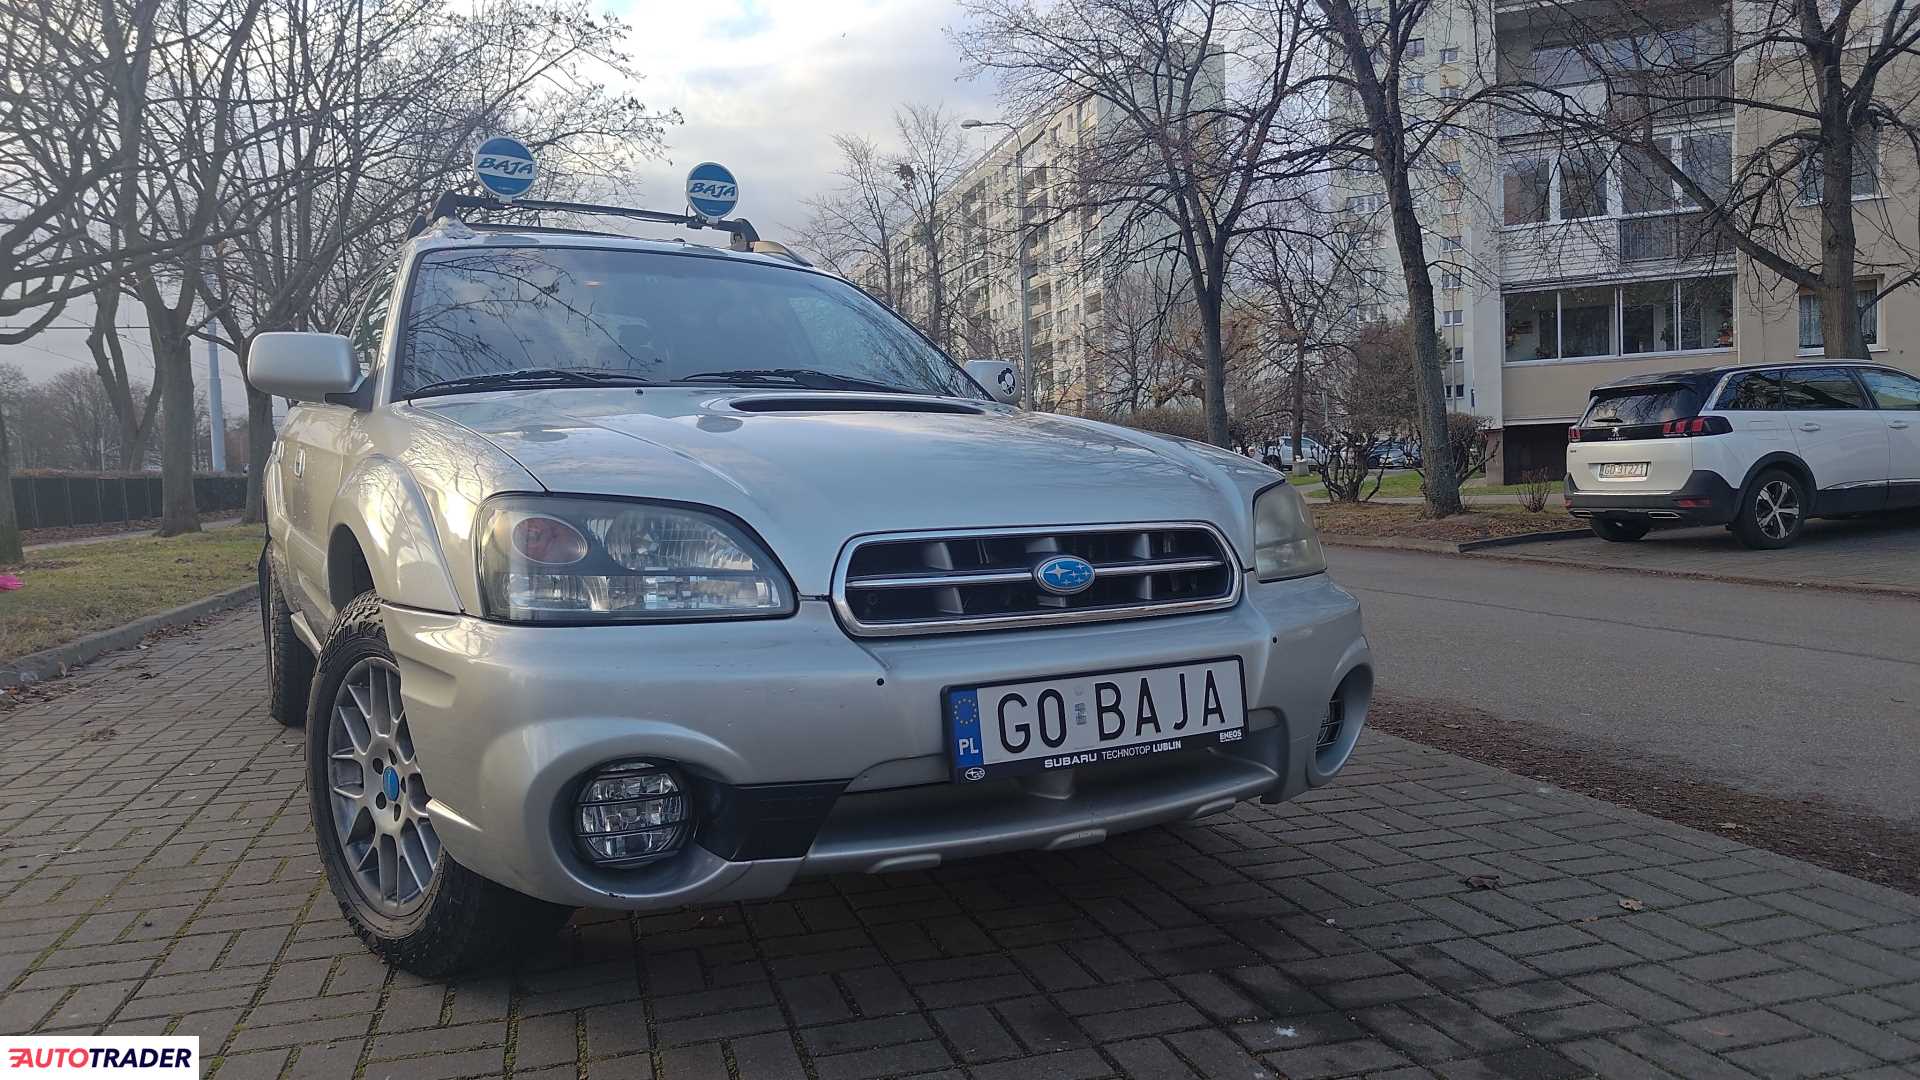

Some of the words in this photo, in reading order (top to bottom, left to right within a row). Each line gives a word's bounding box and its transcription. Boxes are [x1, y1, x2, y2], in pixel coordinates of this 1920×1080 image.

[478, 157, 534, 175] BAJA
[689, 182, 736, 199] BAJA
[1094, 669, 1226, 741] BAJA
[1219, 729, 1242, 741] ENEOS
[958, 737, 979, 756] PL
[1044, 752, 1098, 769] SUBARU
[1102, 745, 1151, 761] TECHNOTOP
[1153, 740, 1182, 753] LUBLIN
